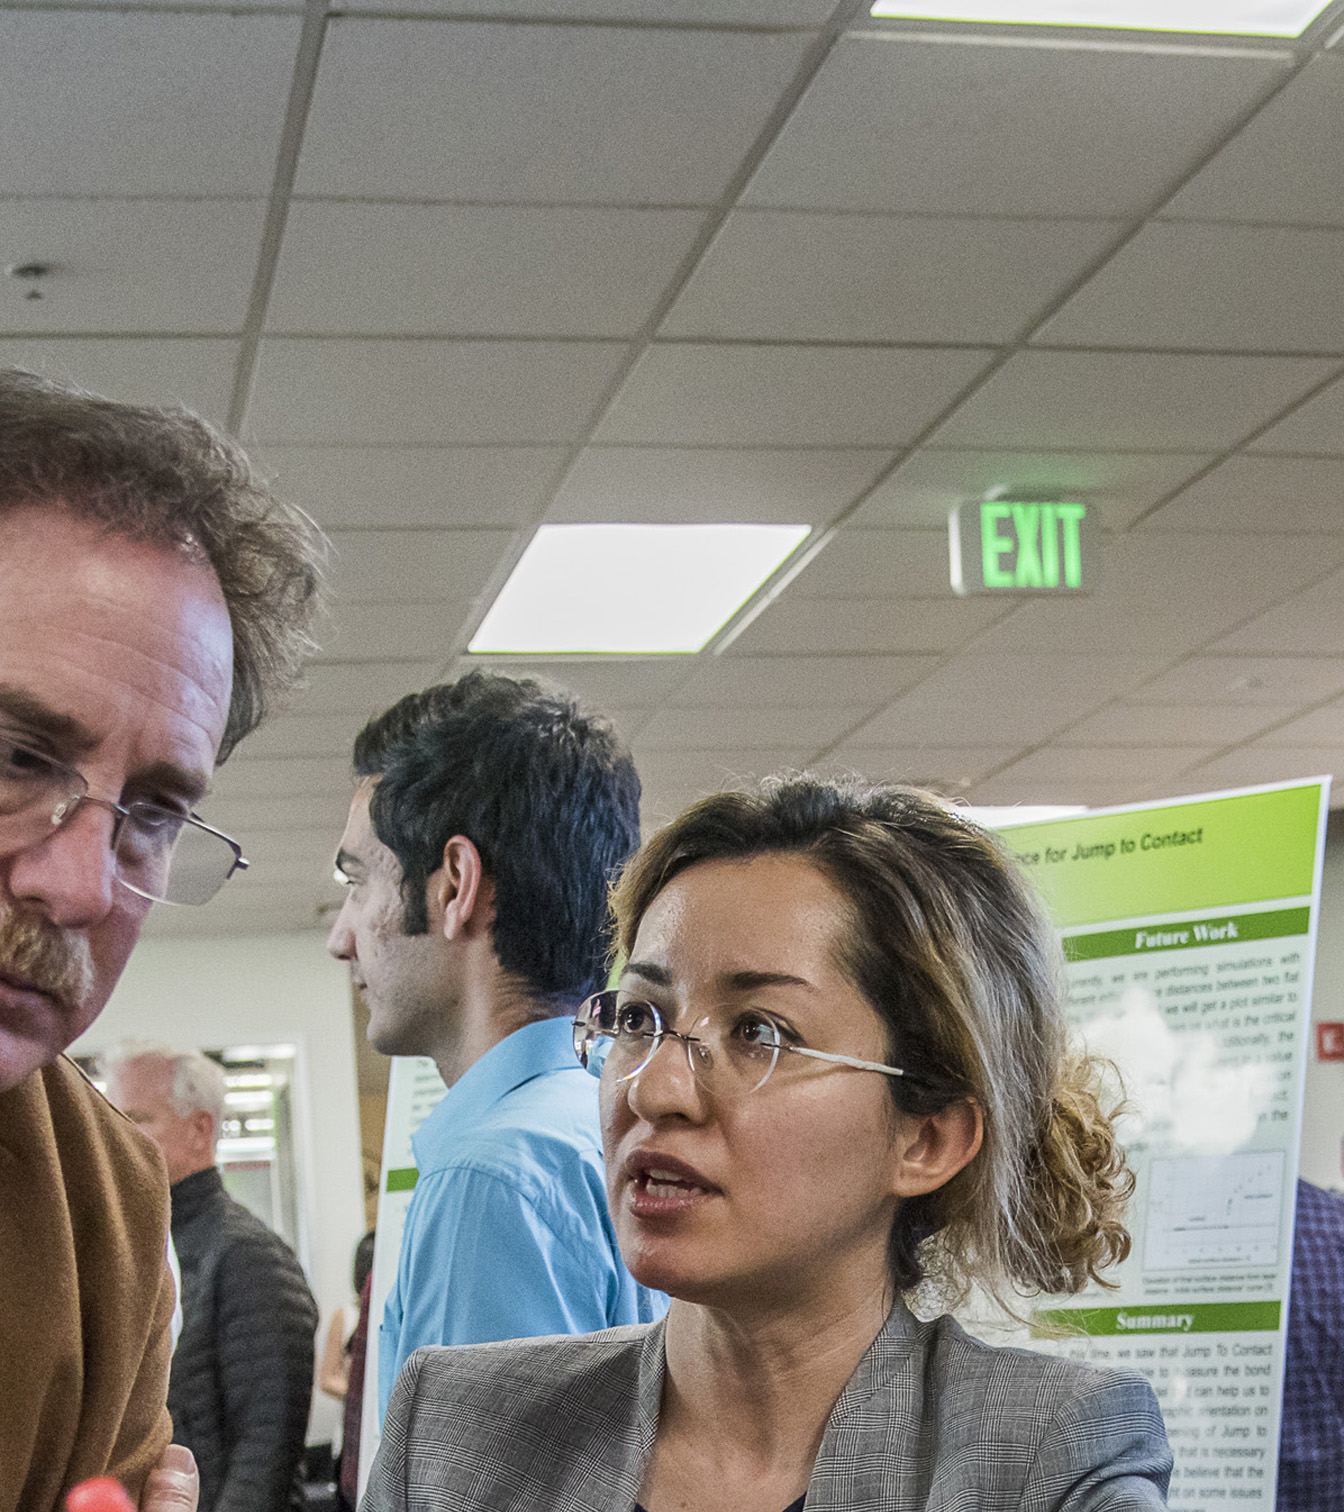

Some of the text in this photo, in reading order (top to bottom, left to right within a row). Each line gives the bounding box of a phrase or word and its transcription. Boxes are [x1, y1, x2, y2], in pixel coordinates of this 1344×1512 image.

[980, 502, 1086, 588] EXIT
[1045, 847, 1067, 864] for
[1072, 842, 1116, 862] Jump
[1120, 838, 1136, 854] to
[1140, 827, 1204, 851] Contact
[1135, 921, 1238, 949] Future Work
[1155, 964, 1209, 981] performing
[1216, 956, 1272, 974] simulations
[1280, 952, 1300, 965] with
[1216, 977, 1258, 993] between
[1262, 975, 1280, 987] two
[1165, 1005, 1178, 1016] we
[1182, 1001, 1197, 1014] will
[1202, 1001, 1217, 1016] get
[1230, 997, 1248, 1013] plot
[1251, 993, 1284, 1007] similar
[1287, 991, 1297, 1003] to
[1244, 1013, 1259, 1026] the
[1262, 1009, 1296, 1024] critical
[1278, 1030, 1294, 1043] the
[1271, 1109, 1288, 1122] the
[1117, 1312, 1194, 1332] Summary
[1135, 1348, 1155, 1359] saw
[1159, 1346, 1178, 1358] that
[1182, 1344, 1212, 1359] Jump
[1216, 1343, 1228, 1357] To
[1232, 1342, 1273, 1357] Contact
[1223, 1364, 1240, 1377] the
[1244, 1363, 1272, 1377] bond
[1216, 1384, 1240, 1399] help
[1242, 1386, 1256, 1397] us
[1259, 1384, 1270, 1396] to
[1254, 1407, 1268, 1417] on
[1221, 1425, 1250, 1439] Jump
[1257, 1424, 1268, 1437] to
[1212, 1447, 1264, 1461] necessary
[1183, 1466, 1219, 1478] believe
[1223, 1465, 1244, 1478] that
[1247, 1465, 1264, 1477] the
[1198, 1487, 1226, 1499] some
[1230, 1486, 1262, 1499] issues
